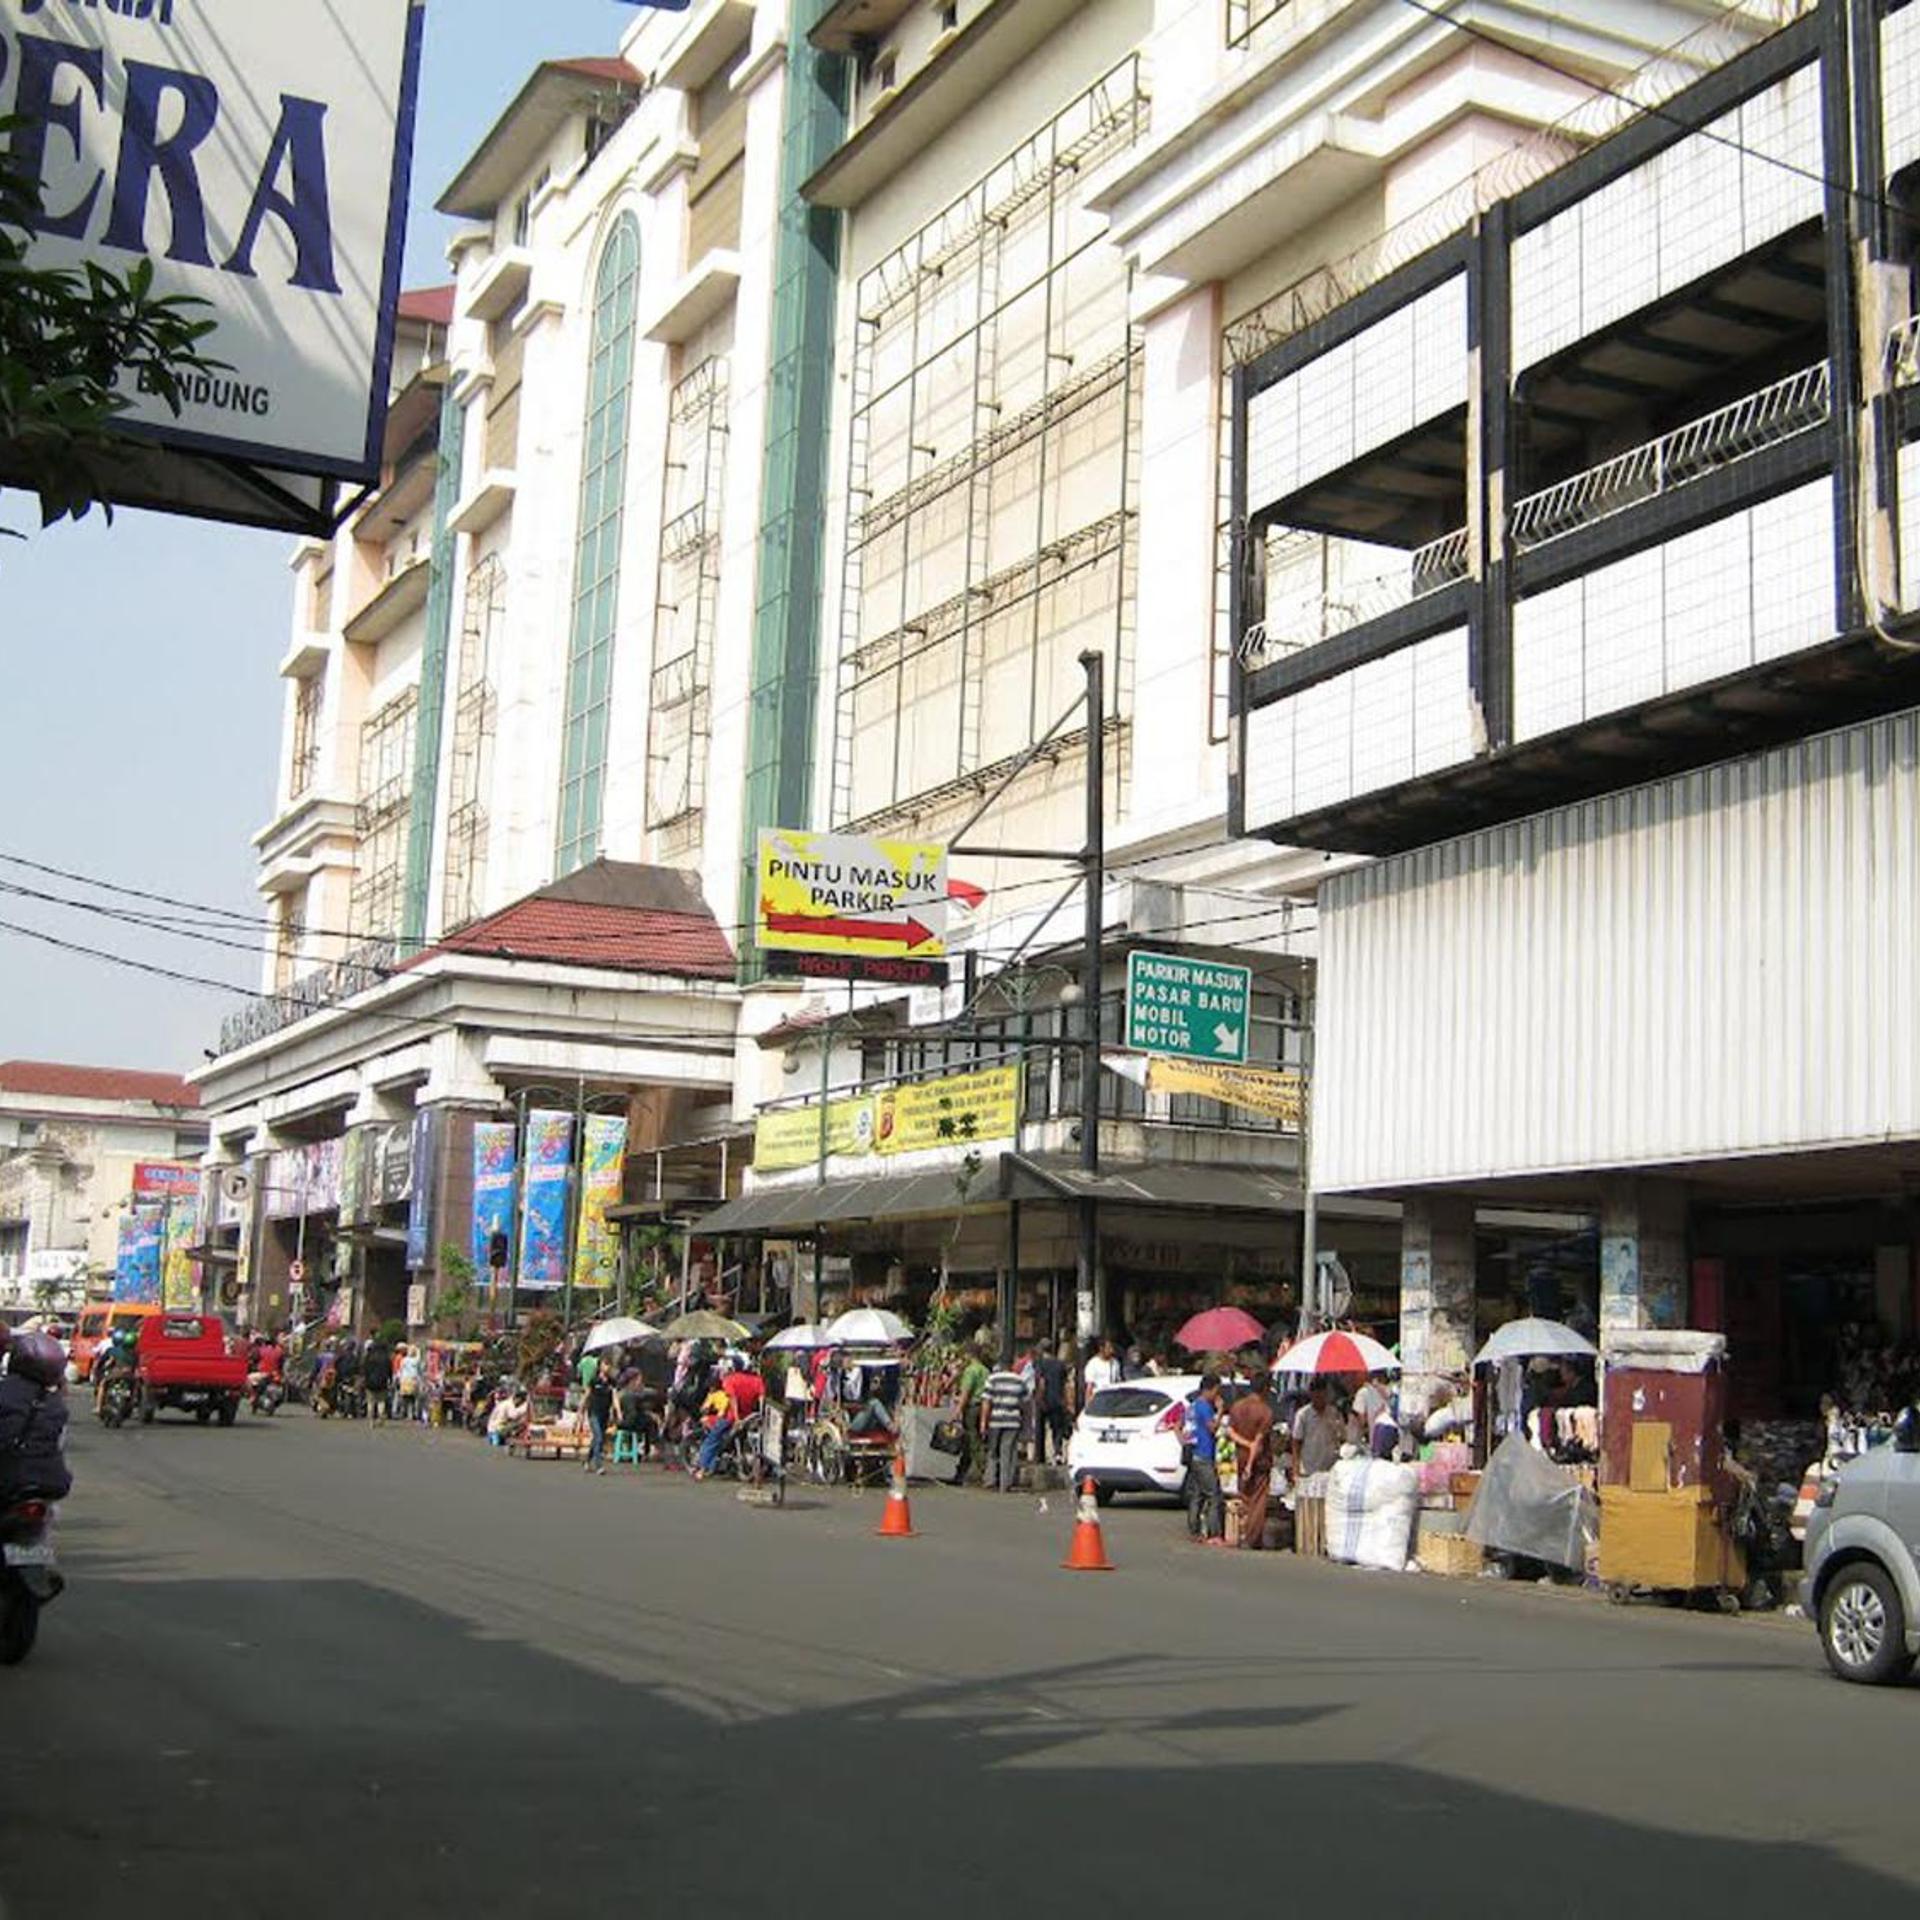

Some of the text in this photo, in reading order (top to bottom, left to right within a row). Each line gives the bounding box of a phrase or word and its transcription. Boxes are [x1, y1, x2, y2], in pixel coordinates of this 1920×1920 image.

[0, 32, 343, 295] ERA
[137, 363, 269, 415] BNDUNG
[769, 859, 937, 891] PINTU MASUK
[811, 887, 895, 912] PARKIR
[1136, 960, 1243, 991] PARKIR MASUK
[1135, 982, 1243, 1013] PASAR BARU
[1135, 1003, 1188, 1027] MOBIL
[1134, 1024, 1191, 1048] MOTOR
